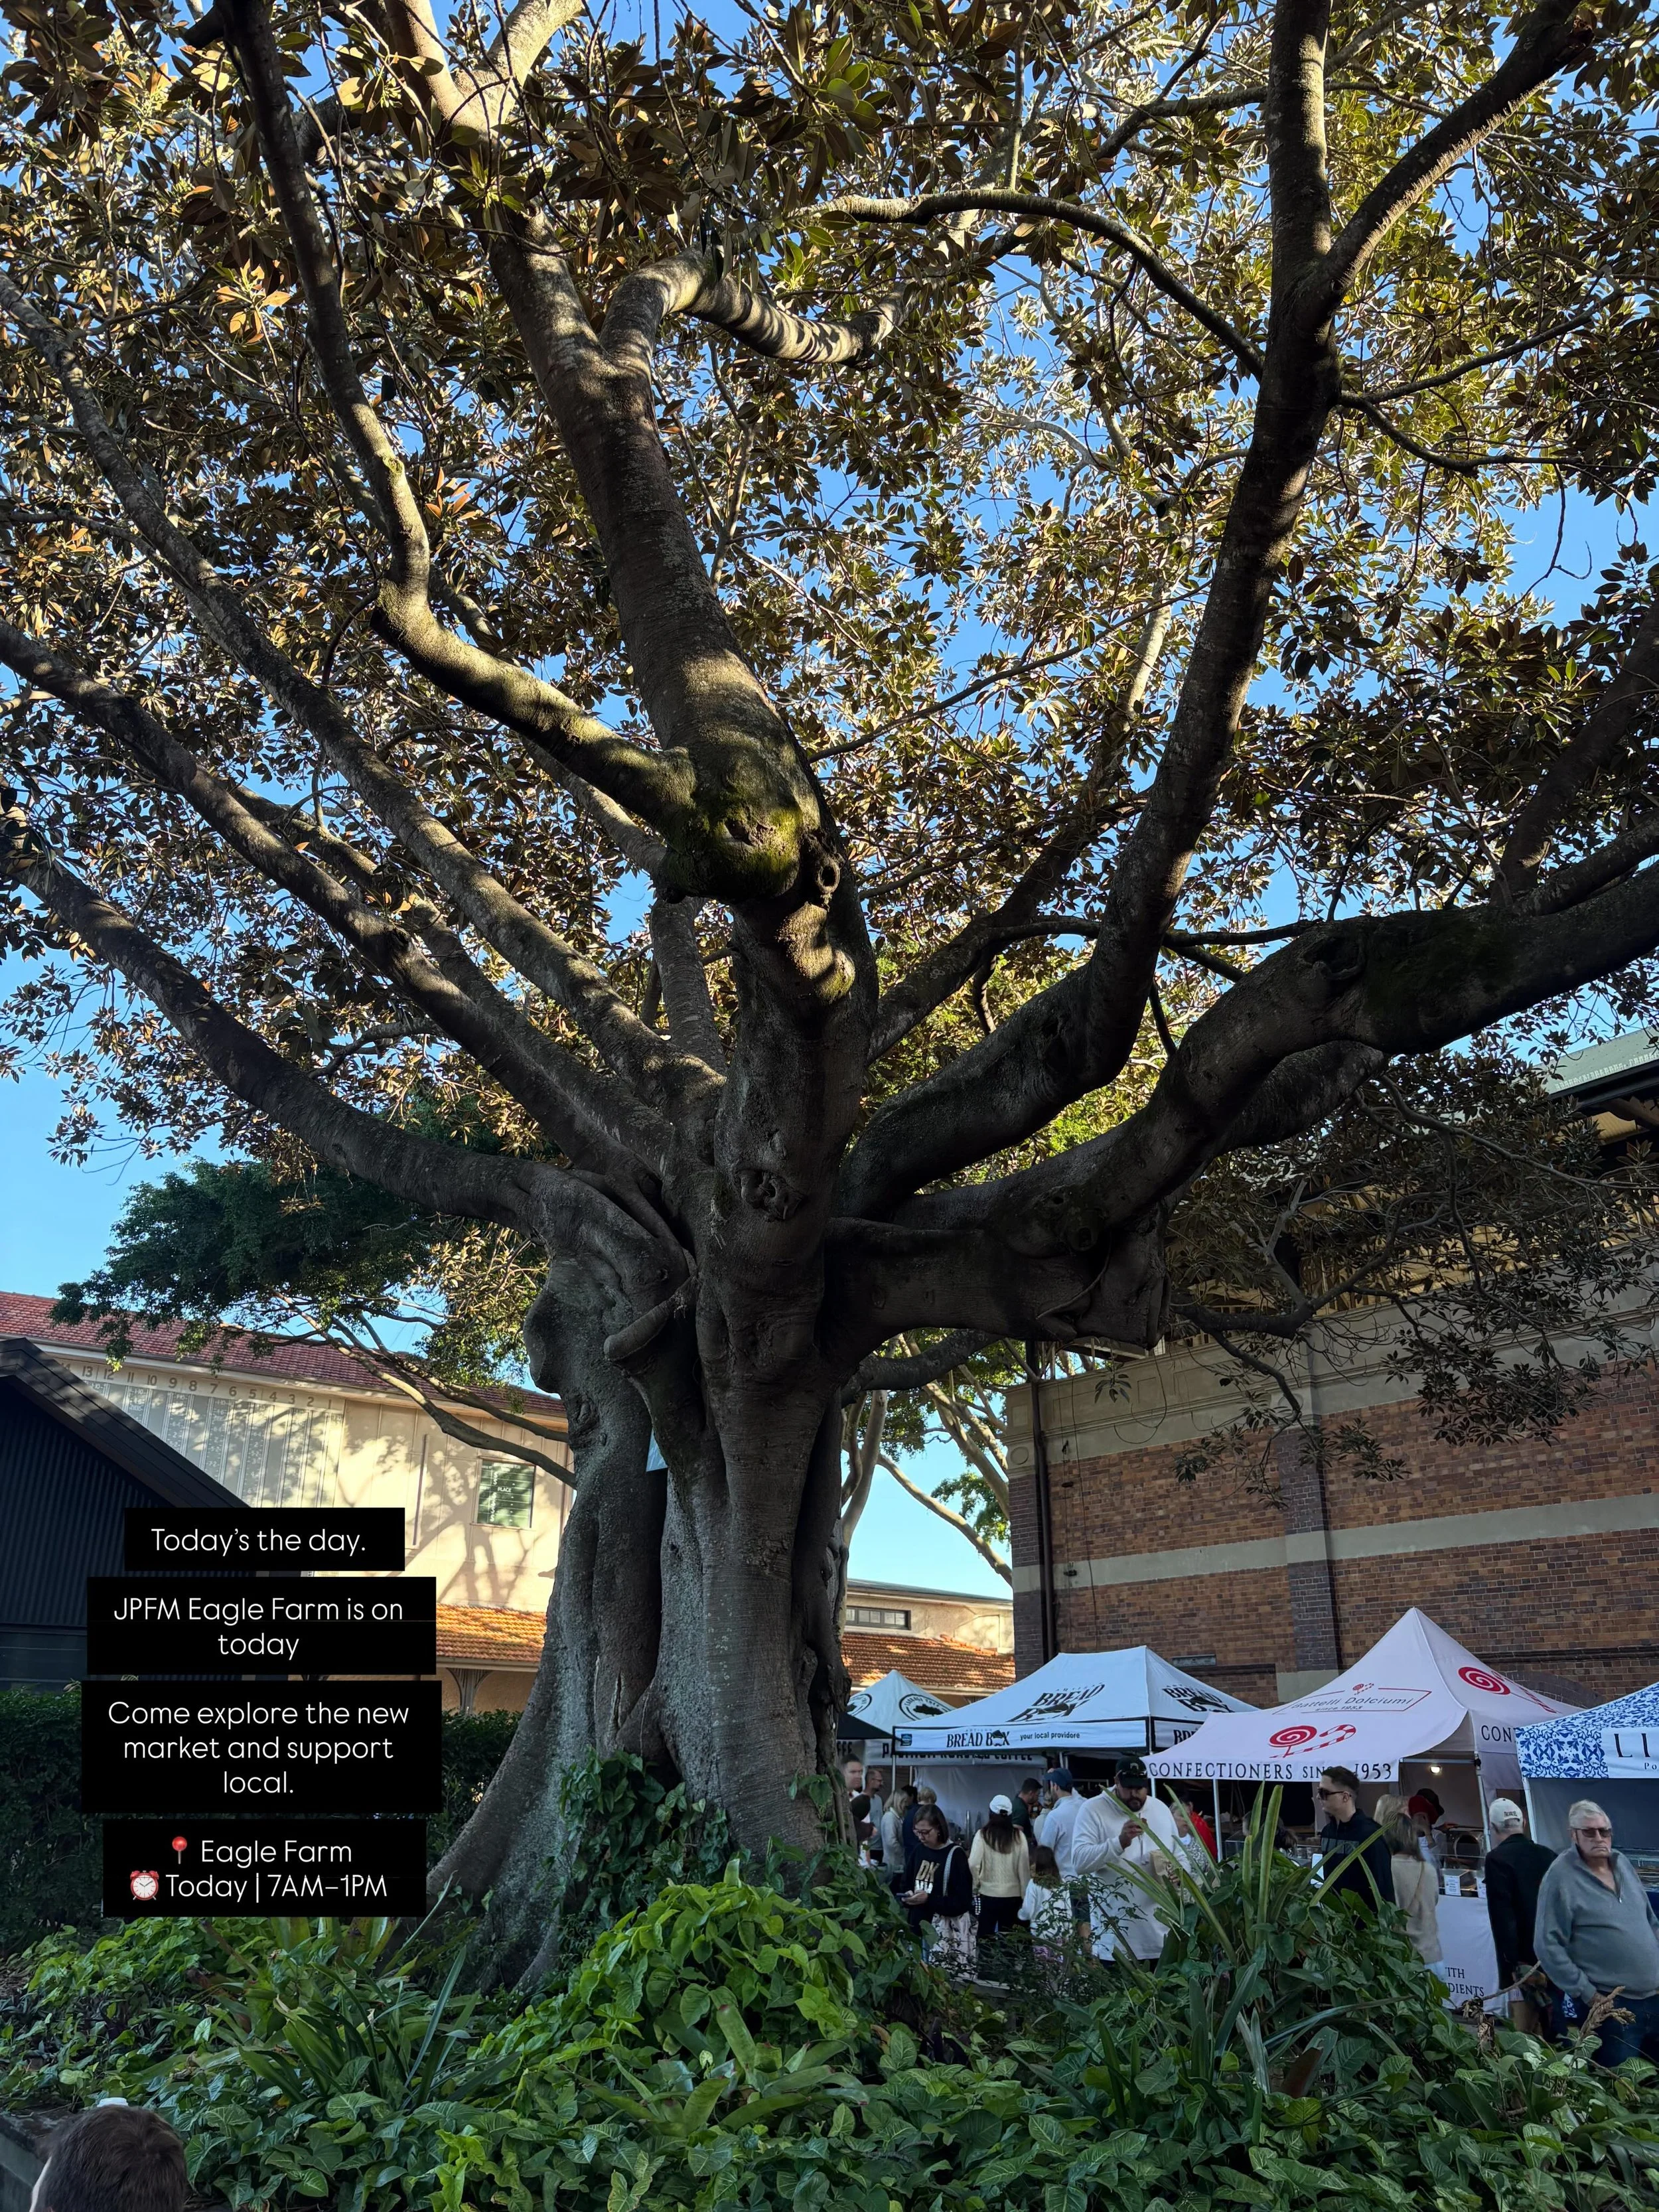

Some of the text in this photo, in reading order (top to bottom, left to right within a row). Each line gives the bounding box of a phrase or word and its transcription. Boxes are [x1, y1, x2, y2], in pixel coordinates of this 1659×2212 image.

[82, 1365, 93, 1377] 13
[104, 1368, 114, 1380] 12
[127, 1372, 135, 1383] 11
[147, 1374, 157, 1386] 10
[169, 1377, 178, 1388] 9
[188, 1380, 197, 1392] 8
[210, 1383, 218, 1394] 7
[229, 1386, 237, 1396] 6
[248, 1388, 257, 1399] 5
[269, 1391, 277, 1402] 4
[289, 1394, 296, 1404] 3
[307, 1396, 315, 1407] 2
[328, 1399, 332, 1409] 1
[1032, 1684, 1106, 1706] BREAD
[946, 1732, 983, 1748] BREAD
[1148, 1762, 1392, 1779] CONFECTIONERS SIN 1953
[1445, 1966, 1465, 1978] ITH
